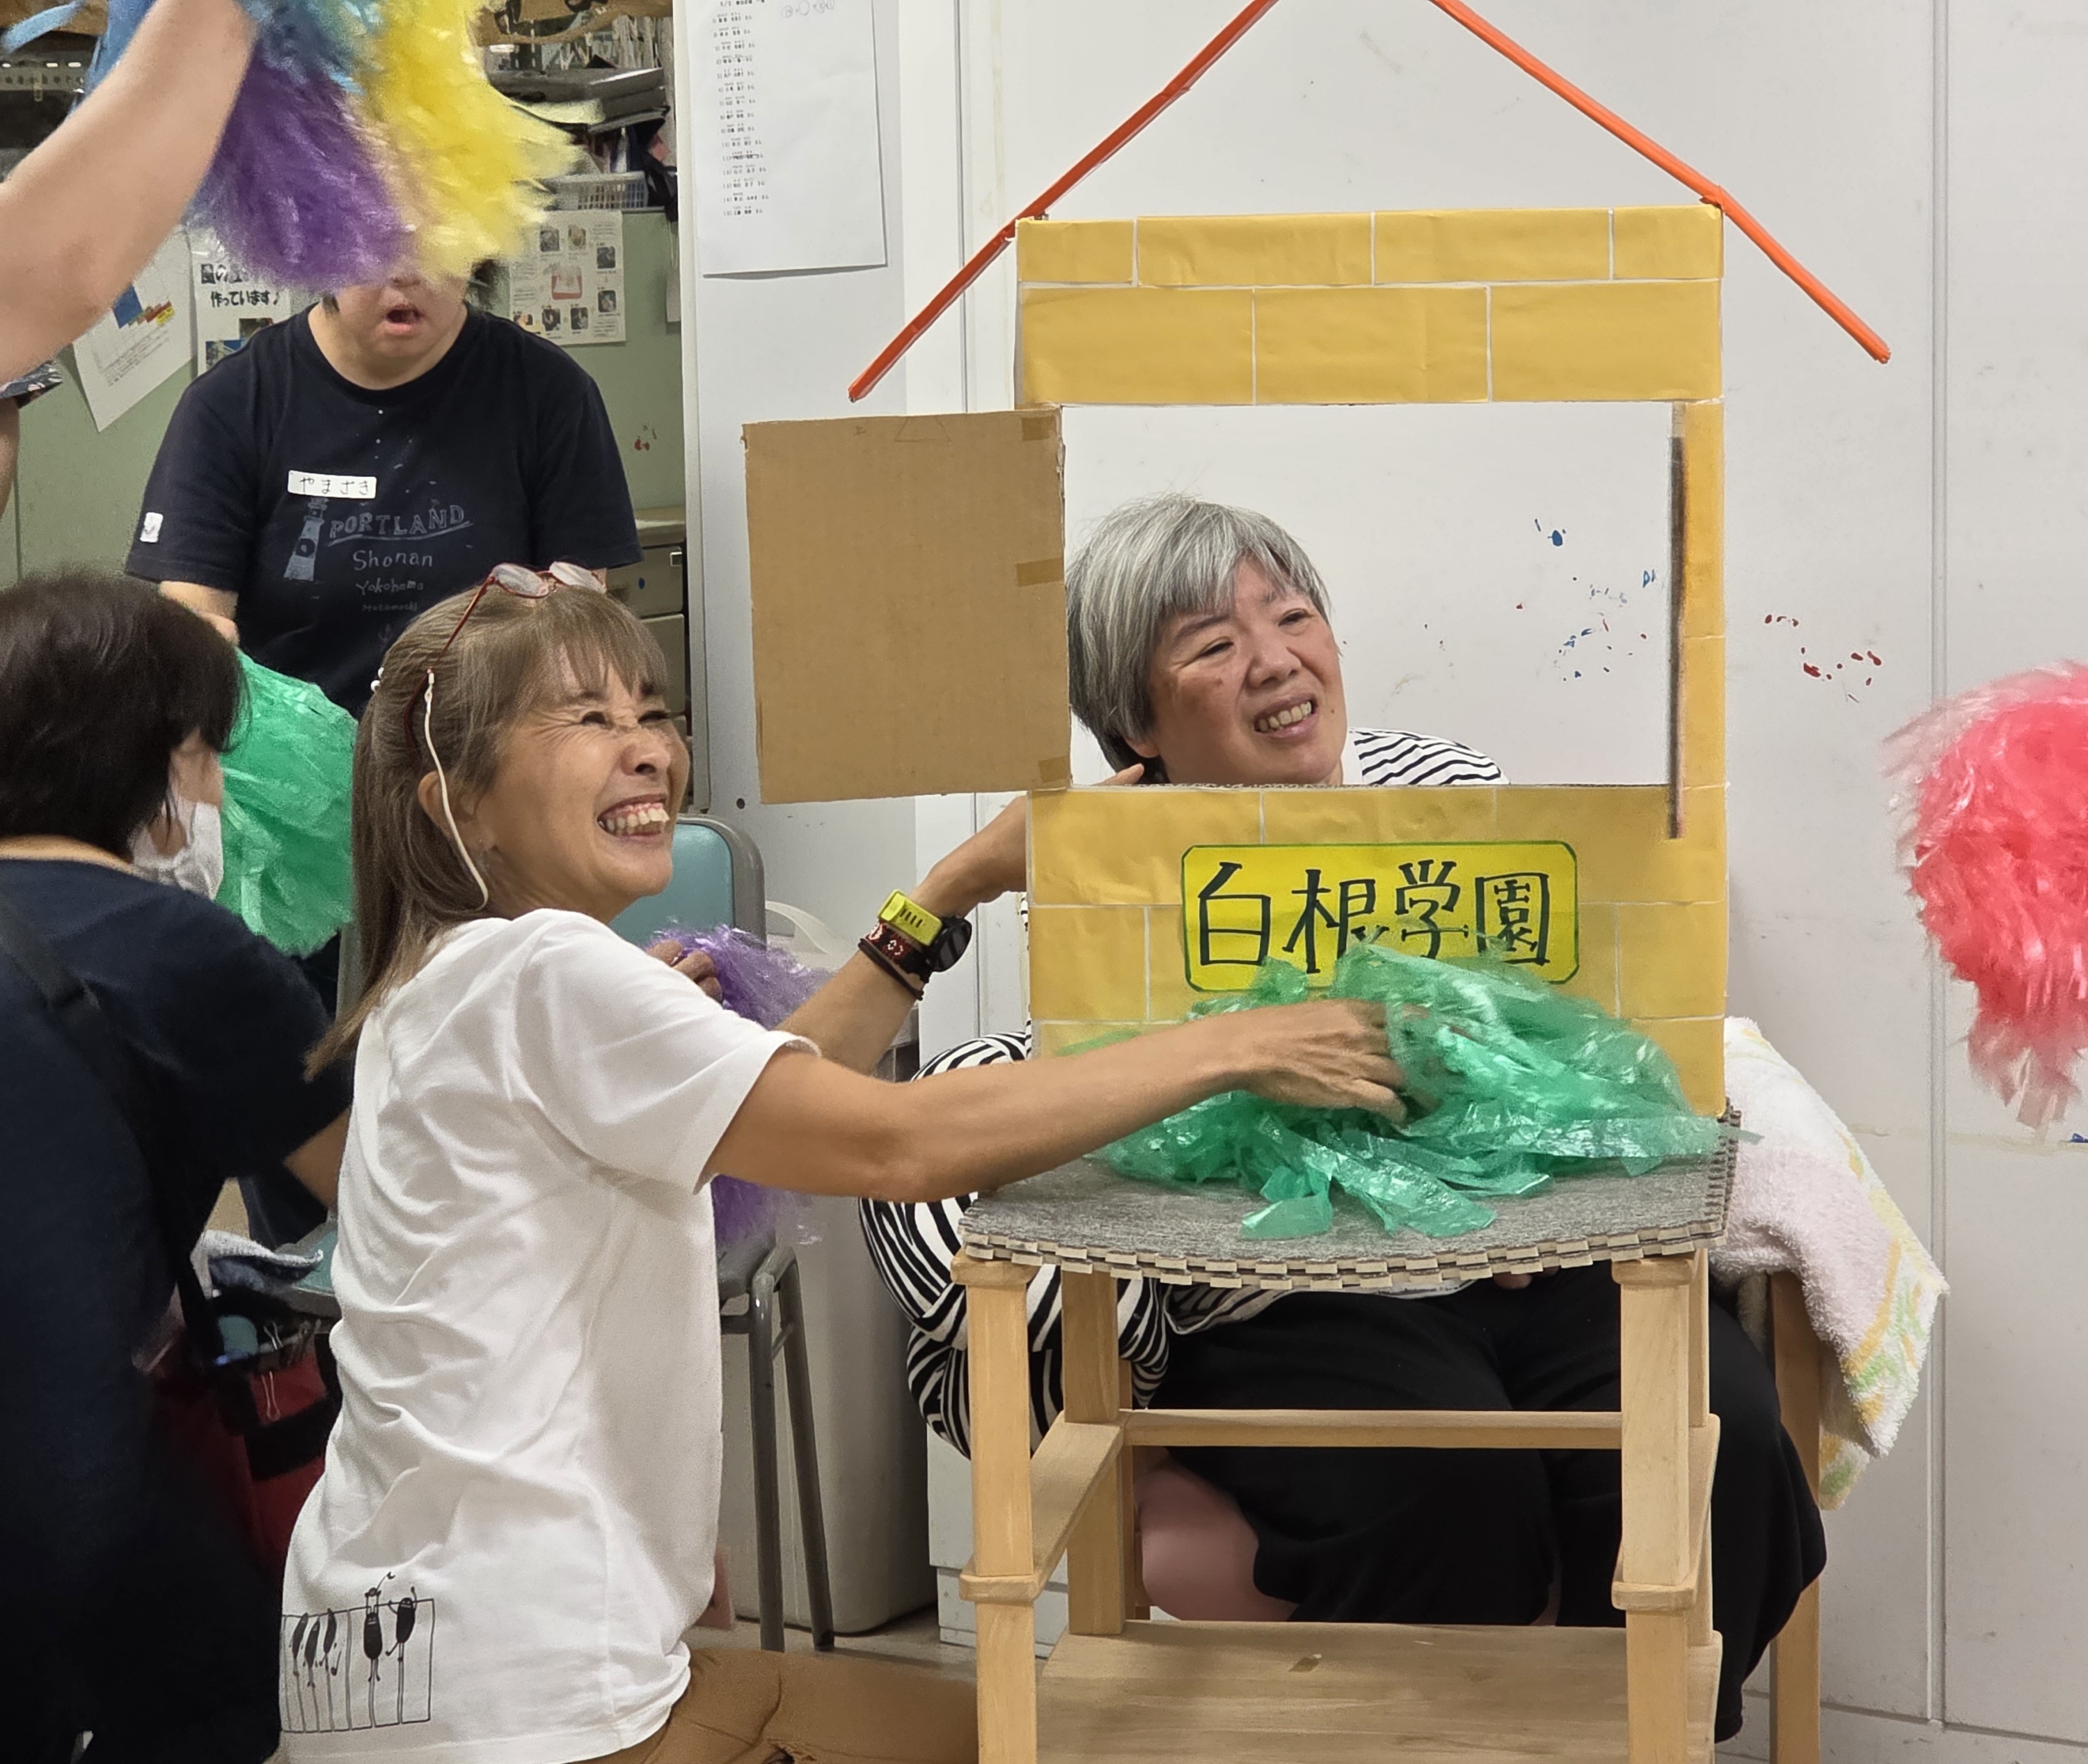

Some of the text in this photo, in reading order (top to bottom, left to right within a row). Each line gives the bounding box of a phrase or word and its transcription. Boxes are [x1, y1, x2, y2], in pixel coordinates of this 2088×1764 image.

[329, 505, 465, 539] PORTLAND
[353, 550, 433, 571] Shonan
[356, 578, 424, 596] Yokohama
[1197, 859, 1551, 975] 白根学園
